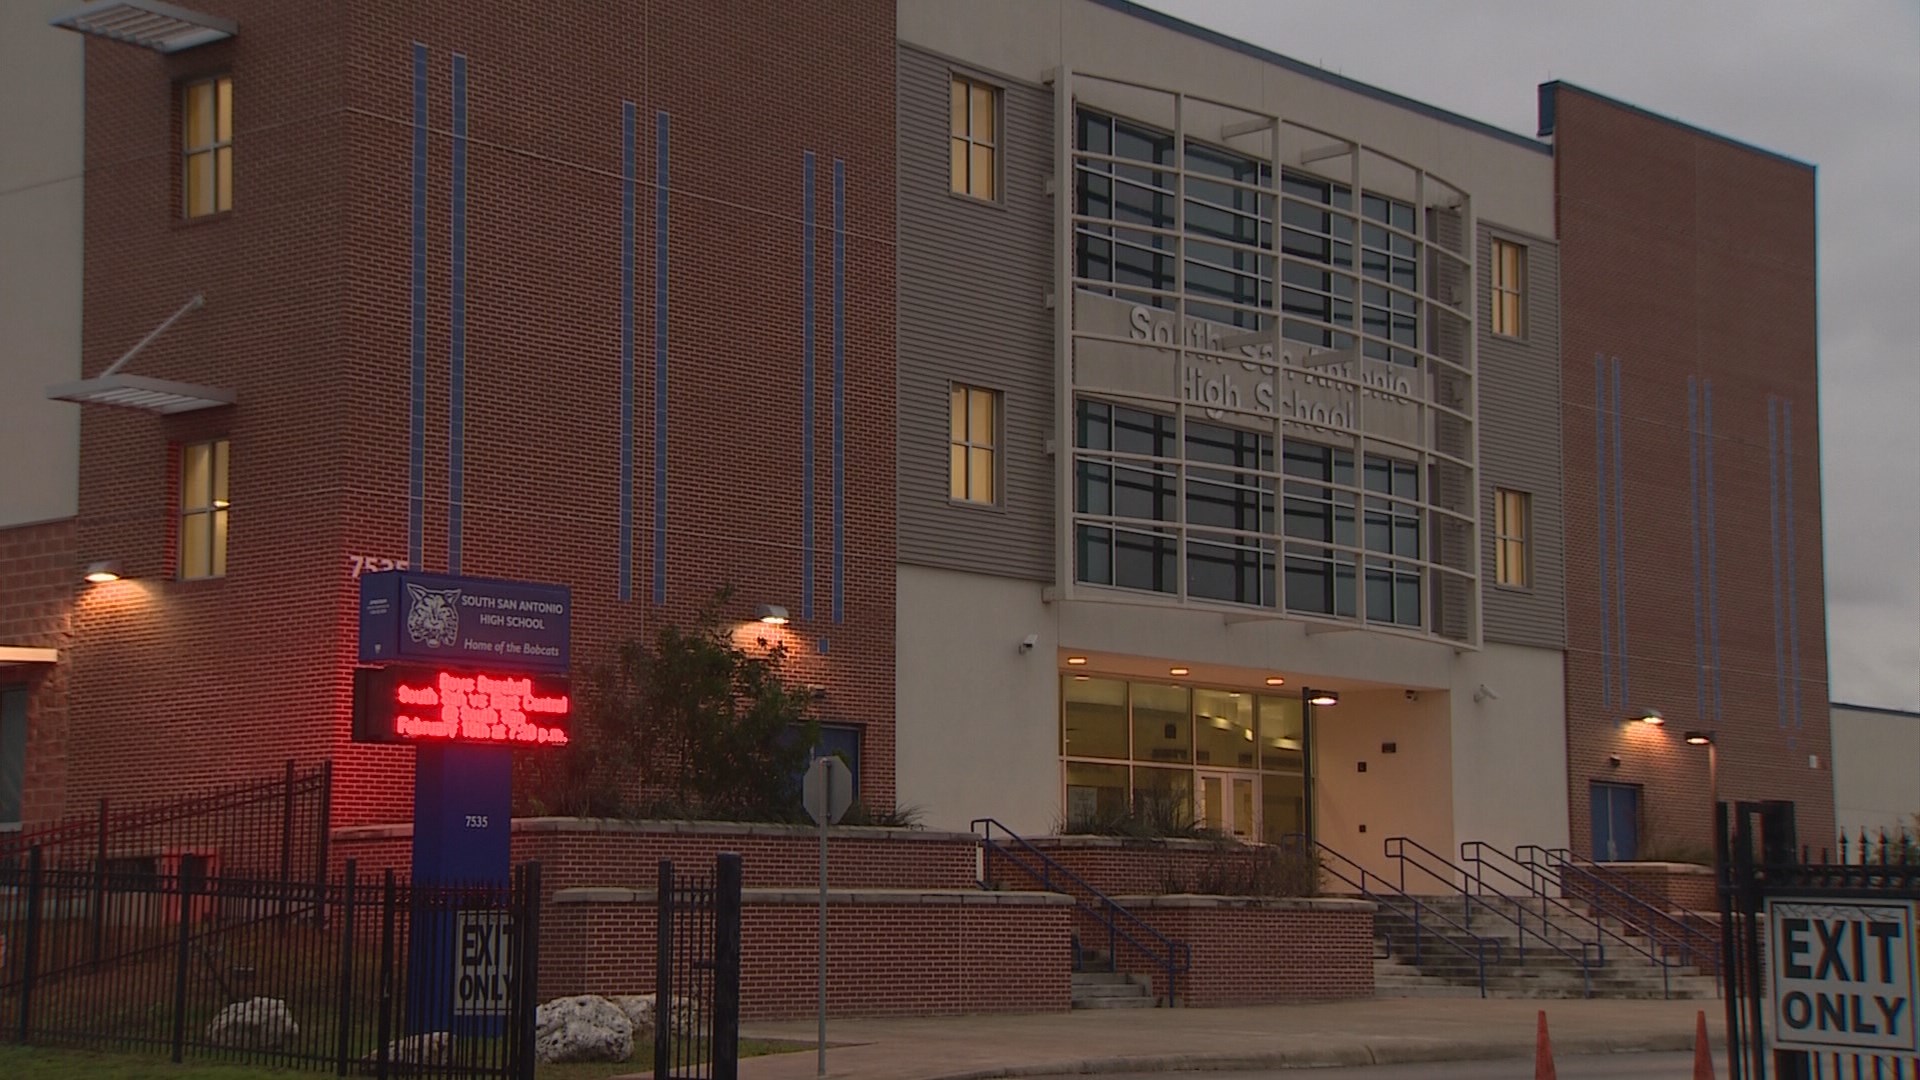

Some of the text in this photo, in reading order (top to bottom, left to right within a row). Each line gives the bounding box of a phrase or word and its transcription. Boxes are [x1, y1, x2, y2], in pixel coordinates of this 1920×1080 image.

[461, 595, 563, 614] SOUTH SAN ANTONIO
[480, 614, 545, 629] HIGH SCHOOL
[464, 638, 560, 656] Home of the Bobcats
[440, 673, 531, 695] Boys Baseball
[398, 686, 438, 704] South
[441, 689, 467, 707] San
[469, 694, 488, 708] vs
[523, 695, 567, 713] Central
[461, 707, 498, 723] South
[501, 709, 525, 724] San
[397, 716, 458, 738] February
[492, 724, 506, 739] at
[538, 728, 568, 743] p.m.
[465, 815, 489, 828] 7535
[461, 924, 515, 967] EXIT
[1781, 918, 1902, 984] EXIT
[459, 974, 515, 1001] ONLY
[1781, 991, 1906, 1035] ONLY
